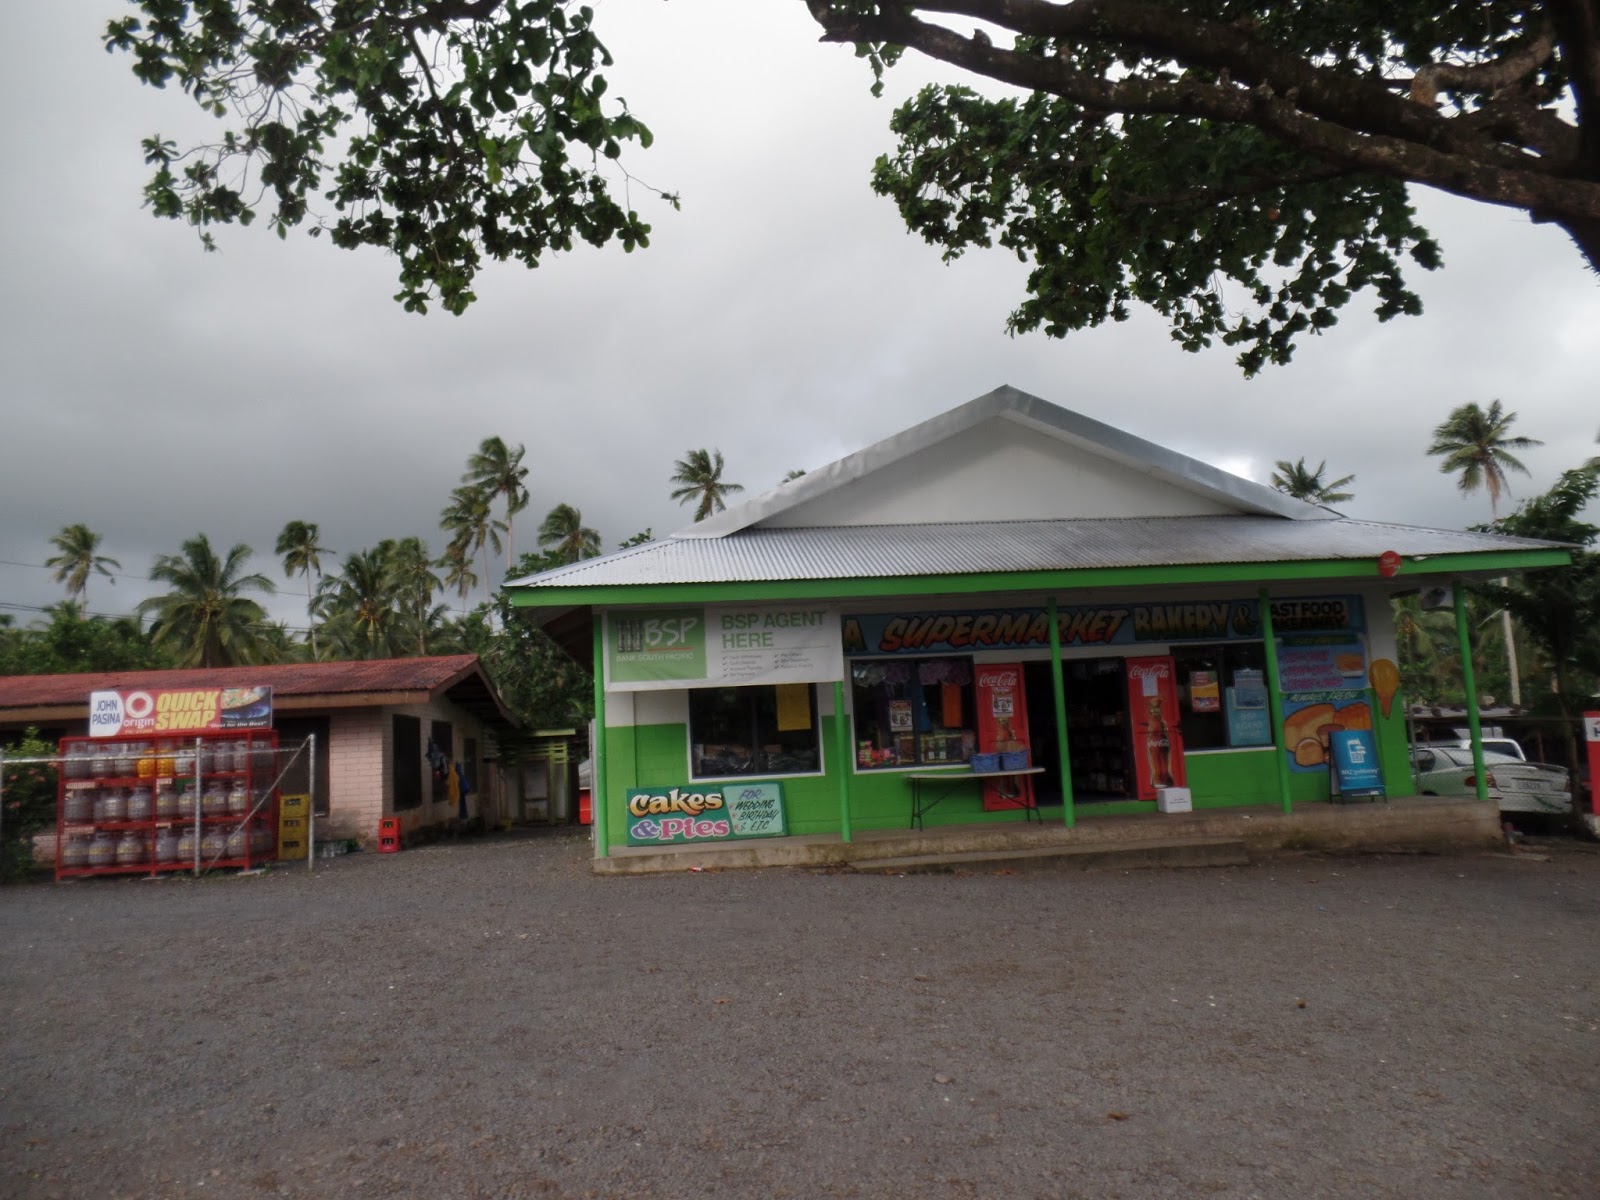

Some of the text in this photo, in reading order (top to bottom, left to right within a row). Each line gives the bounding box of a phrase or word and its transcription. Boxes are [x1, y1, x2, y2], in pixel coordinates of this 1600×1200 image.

[1271, 601, 1344, 617] AST FOOD
[721, 611, 826, 630] BSP AGENT
[880, 609, 1129, 651] SUPERMARKET
[1133, 603, 1230, 640] BAKERY
[1234, 603, 1259, 636] &
[644, 617, 699, 646] BSP
[722, 632, 774, 648] HERE
[616, 652, 694, 663] BANK SOUTH PACIFIC
[96, 700, 118, 711] JOHN
[156, 691, 220, 712] QUICK
[92, 711, 121, 726] PASINA
[123, 716, 155, 730] origin
[155, 711, 215, 730] SWAP
[739, 789, 762, 800] FOR
[629, 788, 724, 818] Cakes
[735, 799, 775, 811] WEDDING
[739, 810, 780, 821] BIRTHDAY
[631, 817, 730, 841] & Pies
